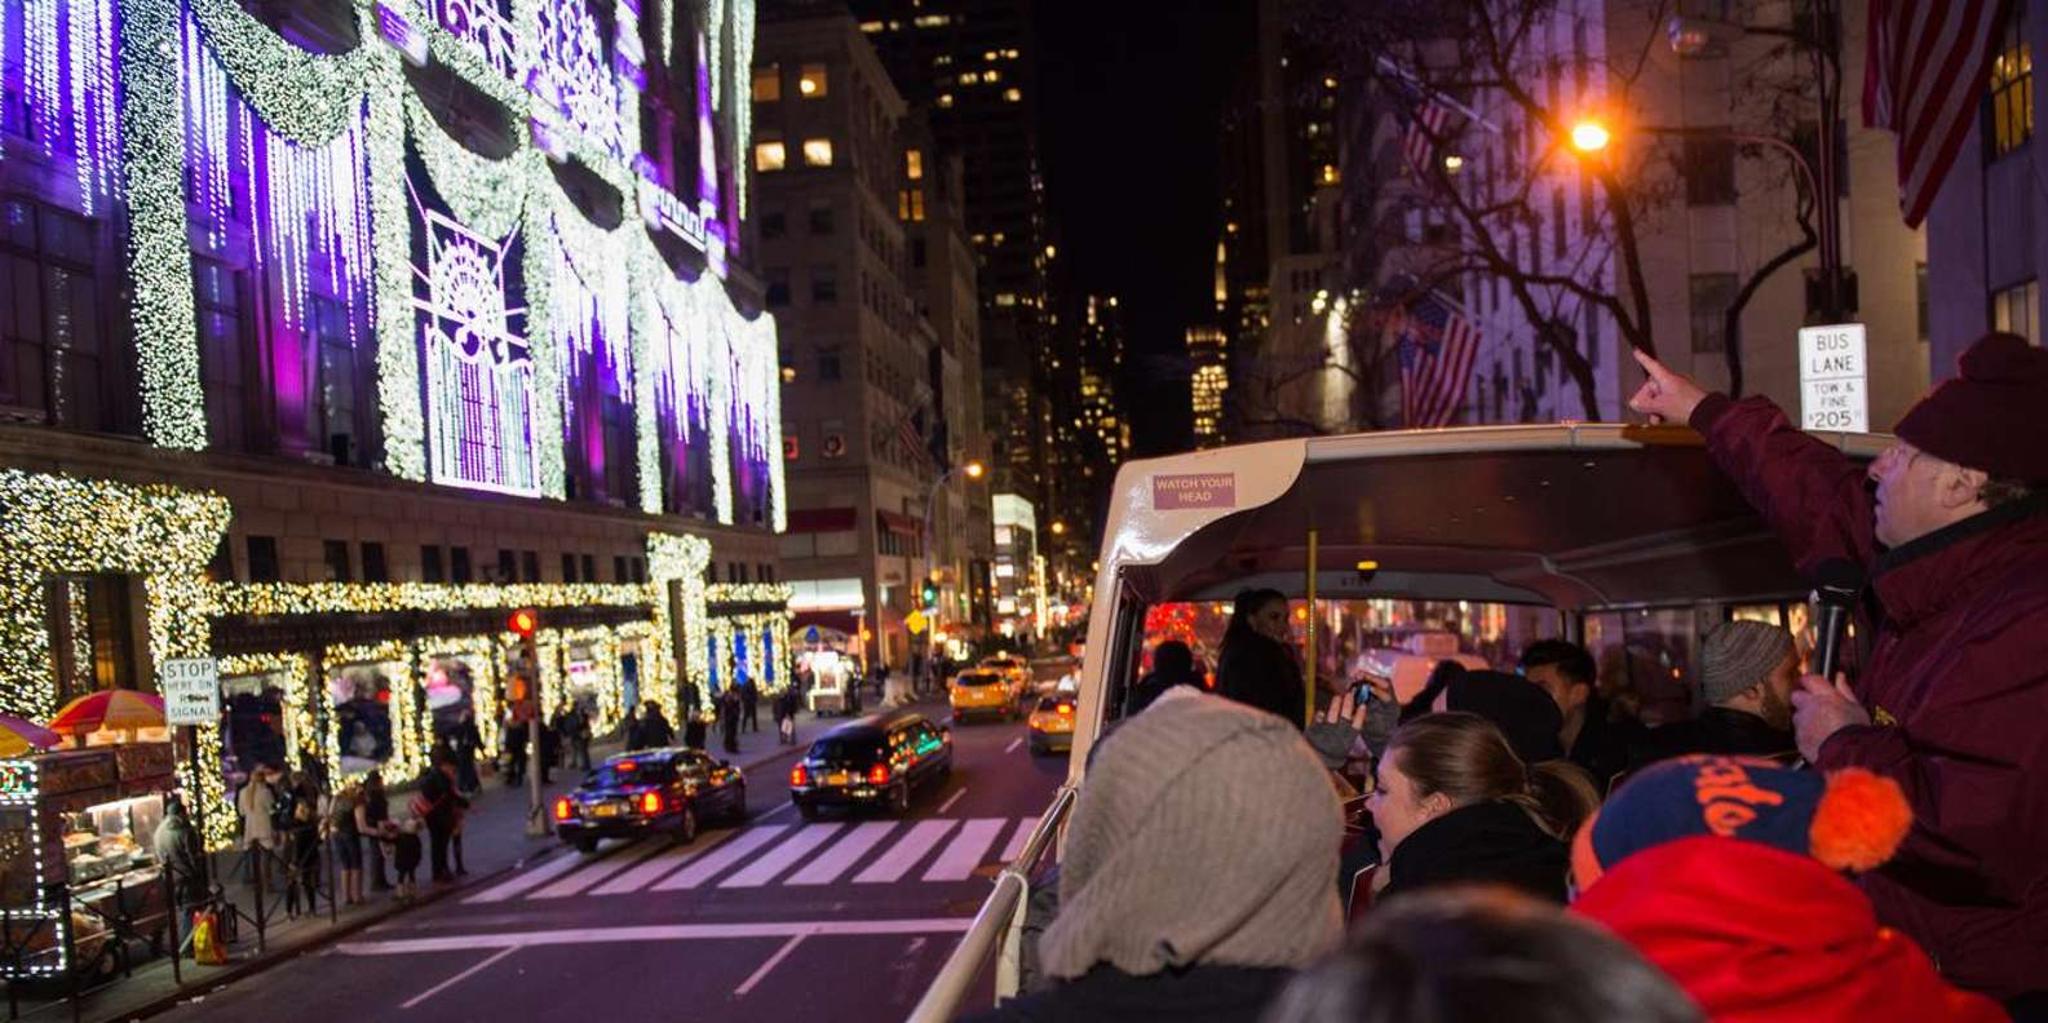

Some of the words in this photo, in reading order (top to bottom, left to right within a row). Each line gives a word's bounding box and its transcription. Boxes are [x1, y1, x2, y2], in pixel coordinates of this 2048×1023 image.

[1816, 333, 1849, 351] BUS
[1812, 355, 1853, 373] LANE
[1814, 383, 1838, 395] TOW
[1845, 382, 1854, 393] &
[1820, 396, 1847, 407] FINE
[1156, 478, 1199, 490] WATCH
[1201, 476, 1233, 488] YOUR
[1179, 491, 1212, 503] HEAD
[167, 662, 212, 679] STOP
[171, 706, 214, 717] SIGNAL
